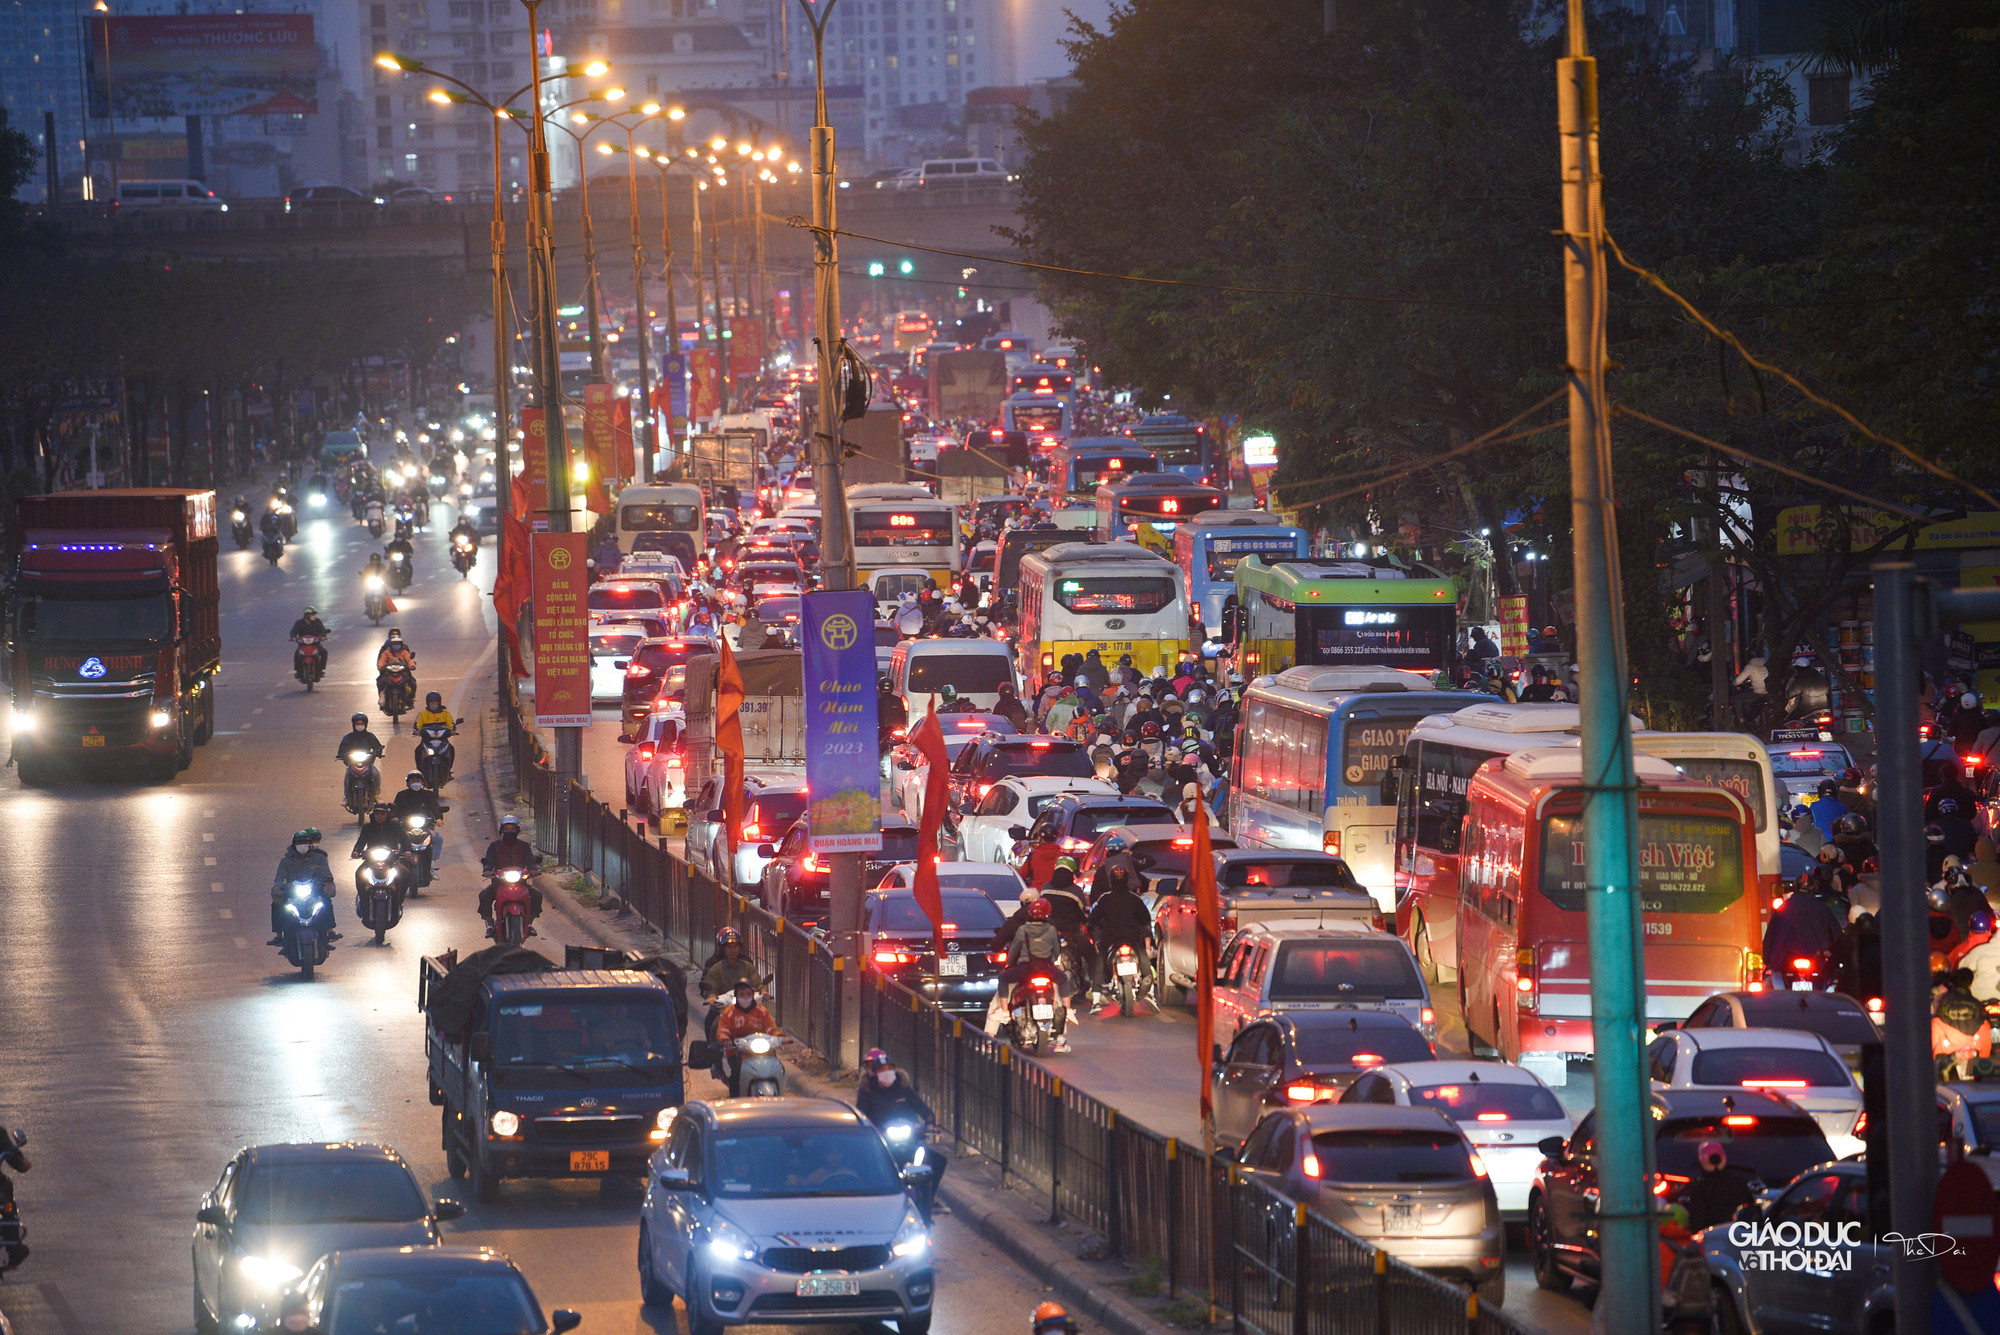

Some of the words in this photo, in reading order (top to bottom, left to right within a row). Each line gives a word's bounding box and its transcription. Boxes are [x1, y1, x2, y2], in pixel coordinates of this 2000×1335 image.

[1216, 540, 1231, 551] 37
[552, 579, 569, 589] ĐẢNG
[546, 592, 562, 604] CỘNG
[563, 591, 577, 601] SẢN
[1501, 597, 1526, 608] PHOTO
[546, 605, 560, 615] VIỆT
[561, 605, 576, 614] NAM
[1504, 609, 1524, 620] COPY
[557, 617, 573, 626] LÃNH
[574, 617, 587, 627] ĐẠO
[549, 628, 557, 639] TỔ
[558, 629, 574, 638] CHỨC
[1097, 642, 1107, 651] 29B
[1502, 637, 1510, 647] IN
[540, 643, 553, 653] MỌI
[44, 656, 81, 670] HƯNG
[102, 656, 143, 672] THỊNH
[537, 654, 551, 664] CỦA
[552, 654, 568, 663] CÁCH
[569, 655, 587, 665] MẠNG
[546, 667, 561, 677] VIỆT
[819, 680, 862, 694] Chào
[818, 700, 864, 714] Năm
[538, 716, 555, 726] QUẬN
[555, 715, 576, 725] HOÀNG
[576, 715, 588, 724] MAI
[824, 720, 858, 735] Mới
[1362, 729, 1394, 746] GIAO
[823, 742, 864, 756] 2023
[1361, 755, 1389, 770] GIAO
[1426, 769, 1436, 791] HÀ
[1437, 771, 1448, 796] NỘI
[1452, 777, 1466, 795] NAM
[1336, 795, 1357, 807] THÀNH
[814, 837, 836, 850] QUẬN
[837, 836, 863, 848] HOÀNG
[864, 836, 879, 846] MAI
[1667, 842, 1715, 873] Việt
[1573, 881, 1586, 889] 091
[1643, 923, 1672, 935] 1539
[621, 1093, 662, 1101] FRONTIER
[581, 1152, 598, 1161] 29C
